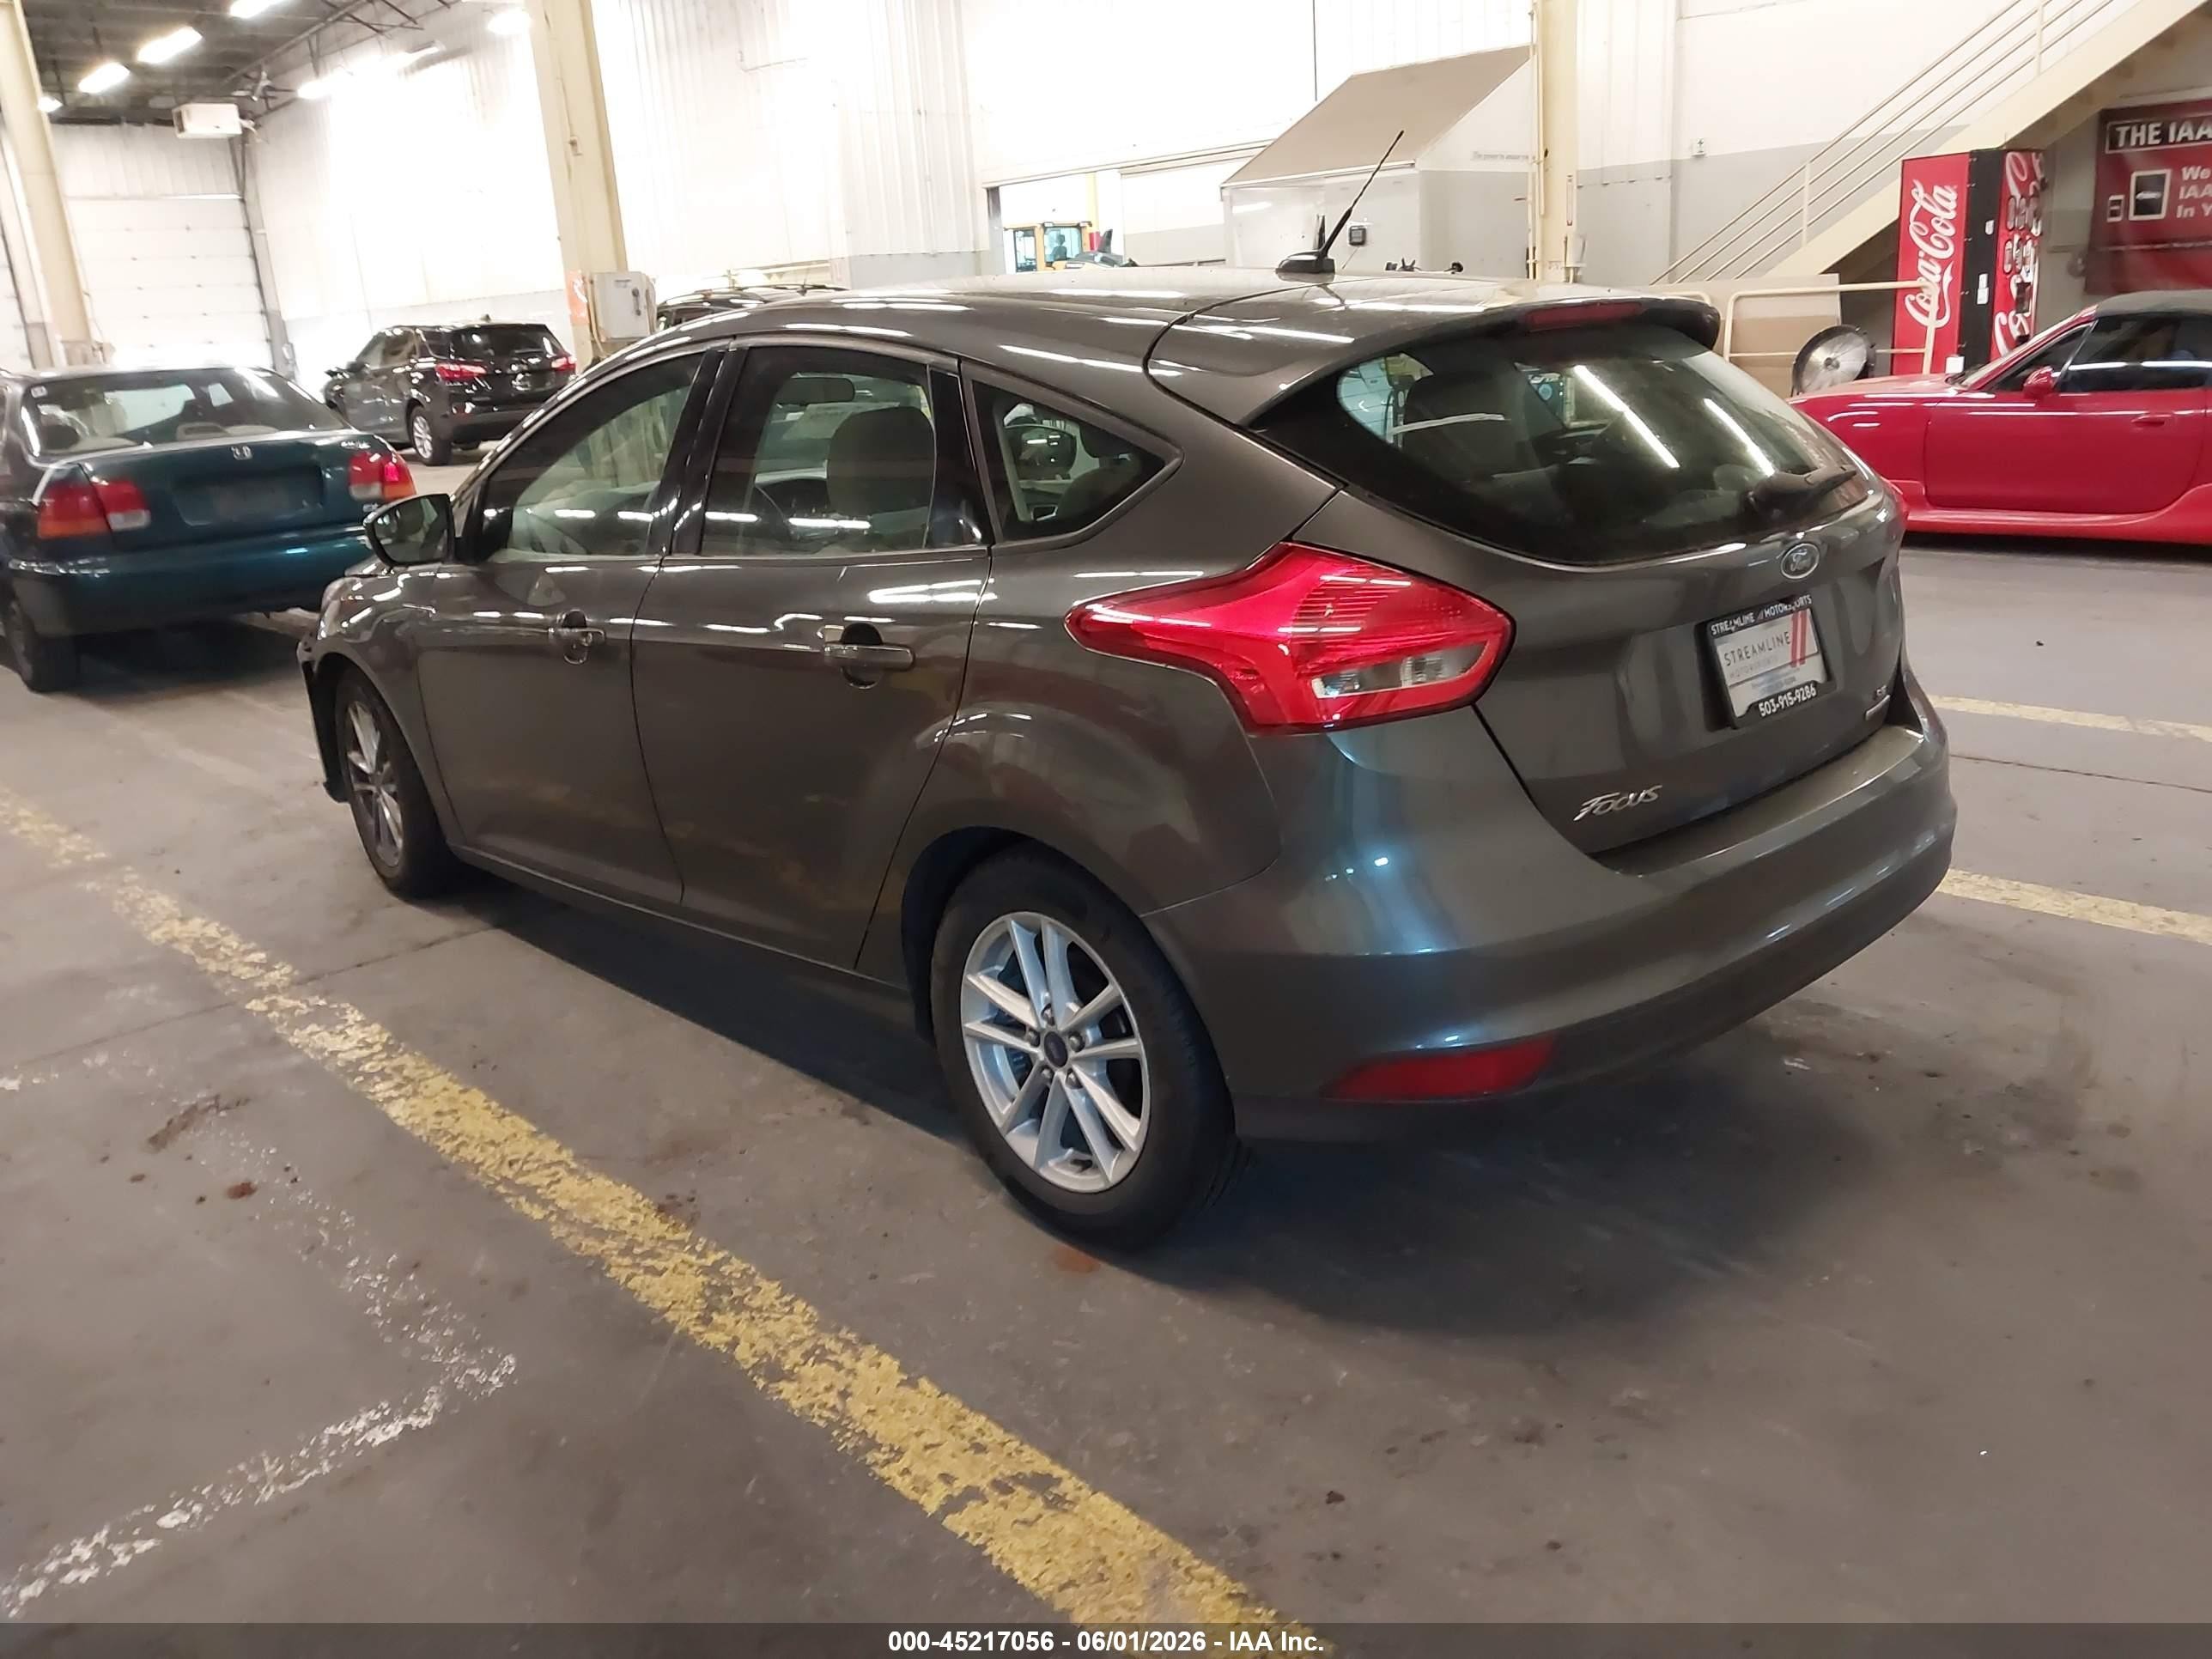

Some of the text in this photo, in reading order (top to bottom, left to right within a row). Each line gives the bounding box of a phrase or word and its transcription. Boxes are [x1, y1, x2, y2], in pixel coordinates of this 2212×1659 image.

[2115, 118, 2212, 148] THE IAA
[2179, 183, 2212, 199] IAA
[2176, 204, 2196, 218] In
[1905, 179, 1958, 328] Coa-Cola
[1711, 611, 1756, 635] STREAMLINE
[1723, 631, 1791, 666] STREAMLINE
[1758, 684, 1817, 717] 503-915-9286
[1572, 784, 1663, 821] Focus
